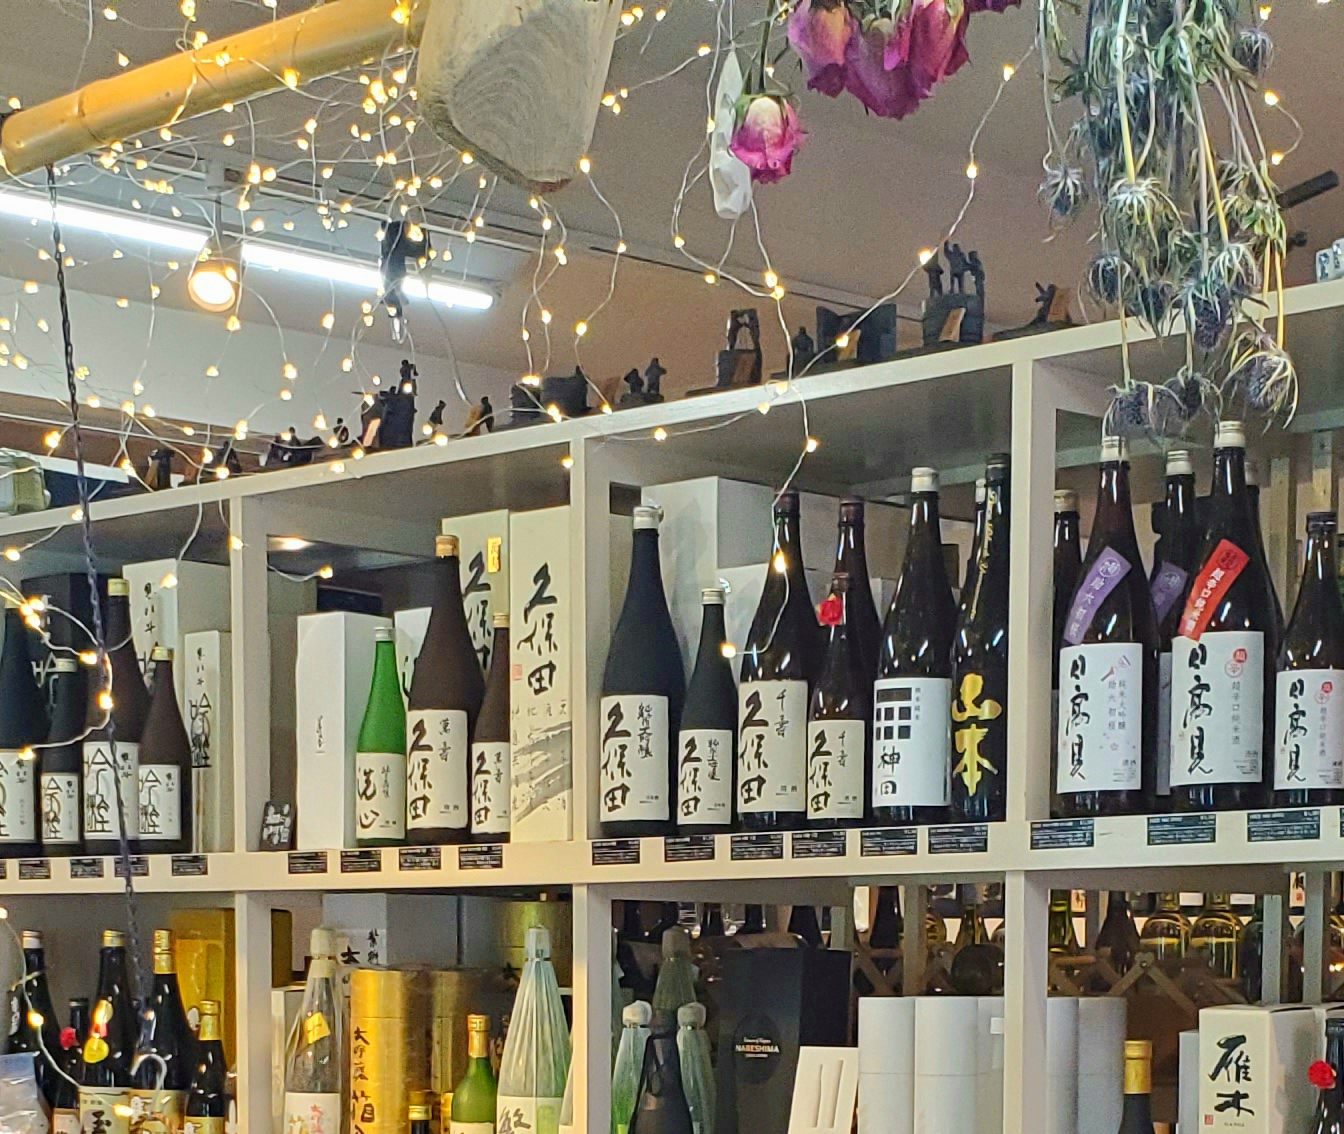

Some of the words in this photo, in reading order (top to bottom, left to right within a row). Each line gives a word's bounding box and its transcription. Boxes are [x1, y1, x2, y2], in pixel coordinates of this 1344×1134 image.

[516, 562, 558, 696] 久保田
[602, 701, 632, 813] 久保田
[739, 689, 770, 805] 久保田
[951, 672, 1003, 797] 山本
[1066, 654, 1091, 781] 日高見
[1182, 643, 1214, 776] 日高見
[1284, 678, 1307, 782] 日高見
[408, 718, 434, 822] 久保田
[472, 750, 492, 826] 久保田
[679, 736, 703, 817] 久保田
[809, 729, 833, 813] 久保田
[1208, 1034, 1255, 1118] 雁木
